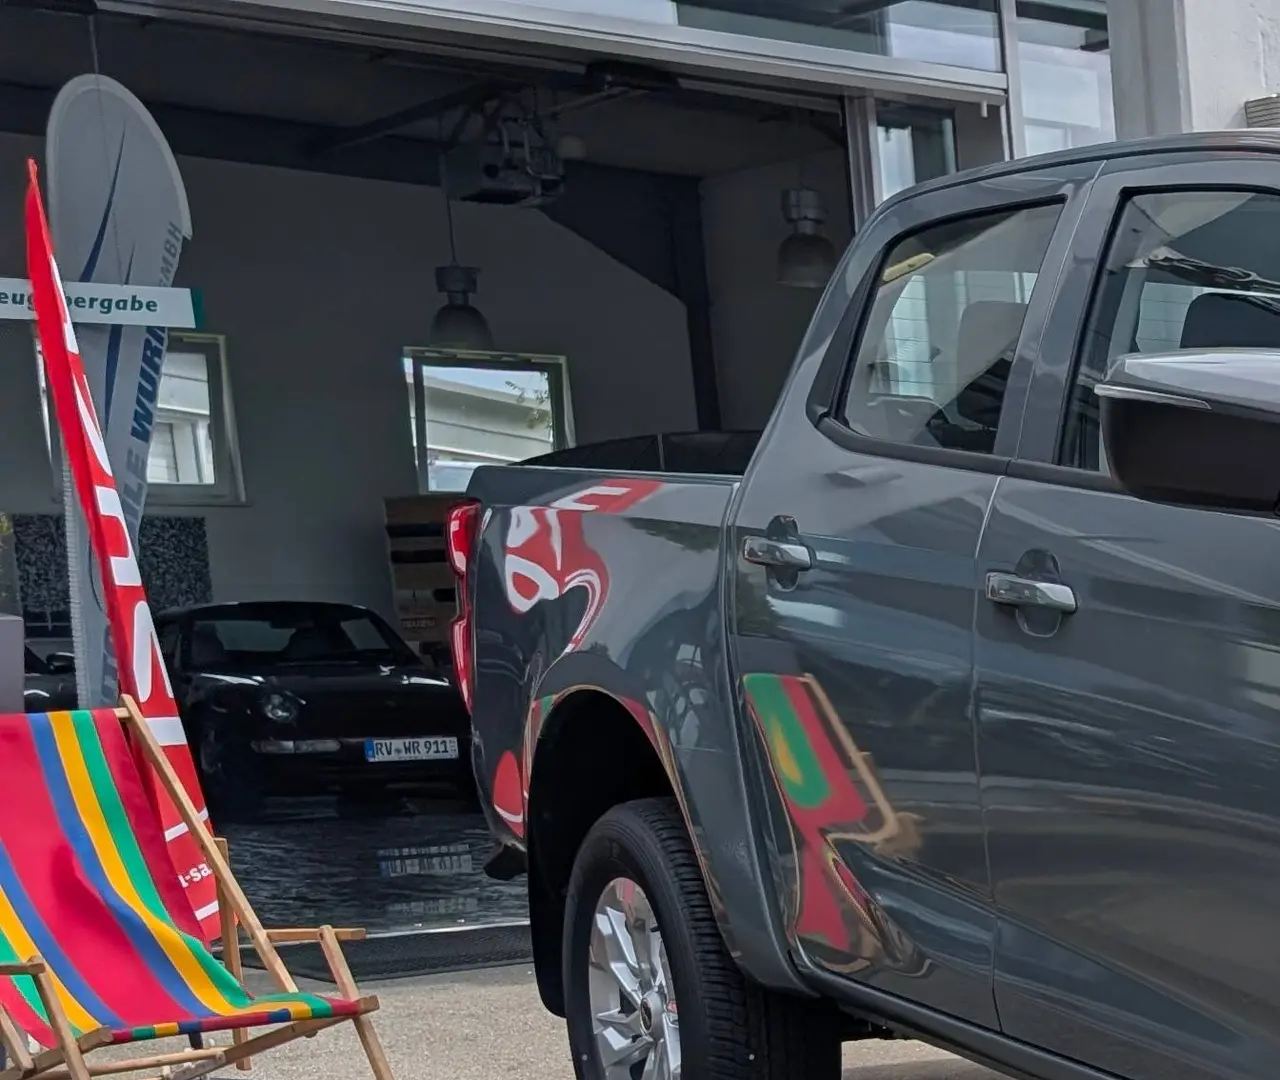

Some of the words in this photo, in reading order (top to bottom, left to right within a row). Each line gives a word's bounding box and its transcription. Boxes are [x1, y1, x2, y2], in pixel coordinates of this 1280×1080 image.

[375, 742, 393, 756] RV
[402, 740, 420, 755] WR
[424, 739, 449, 754] 911
